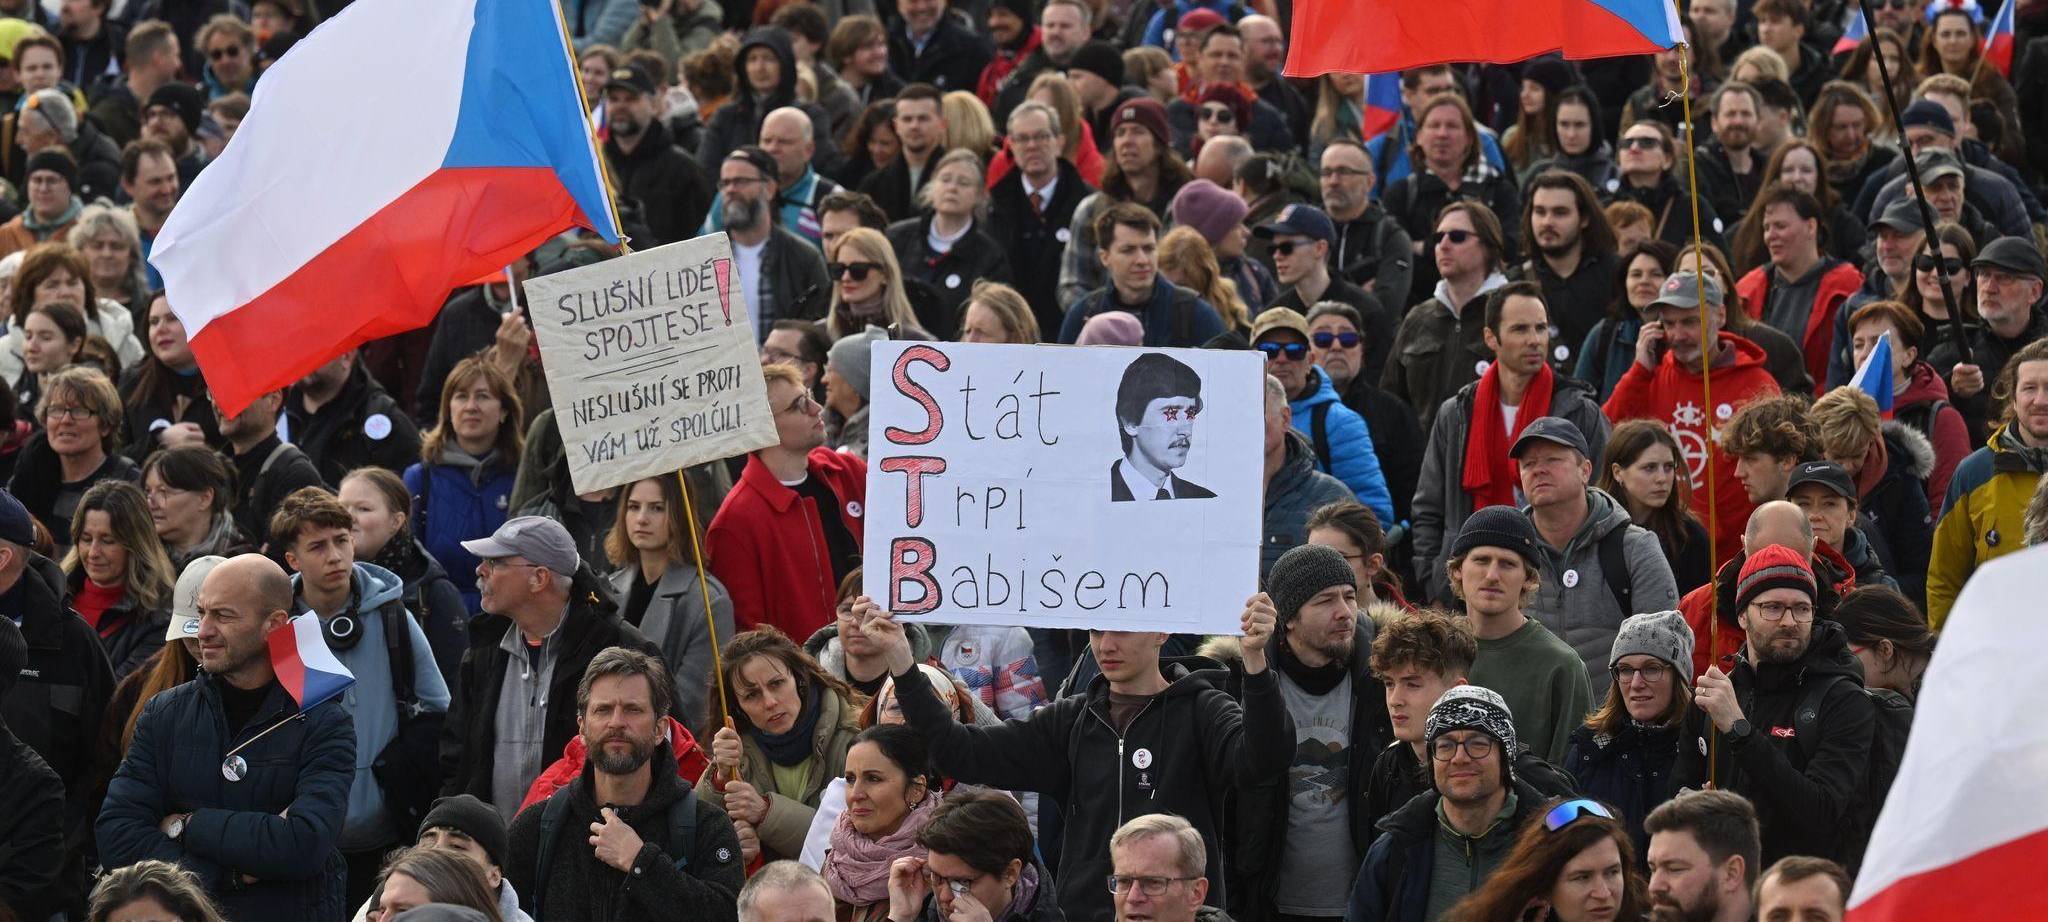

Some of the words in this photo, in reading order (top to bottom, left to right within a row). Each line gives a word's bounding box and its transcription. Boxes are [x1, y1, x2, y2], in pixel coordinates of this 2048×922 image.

[558, 269, 656, 326] SLUŠNÍ
[572, 375, 669, 428] NESLUŠNÍ
[671, 376, 691, 401] SE
[696, 364, 742, 397] PROTI
[883, 343, 1061, 446] Stát
[582, 431, 627, 464] VÁM
[635, 417, 663, 451] UŽ
[669, 400, 747, 443] SPOLČILI.
[879, 455, 1034, 530] Trpí
[888, 536, 1172, 616] Babišem
